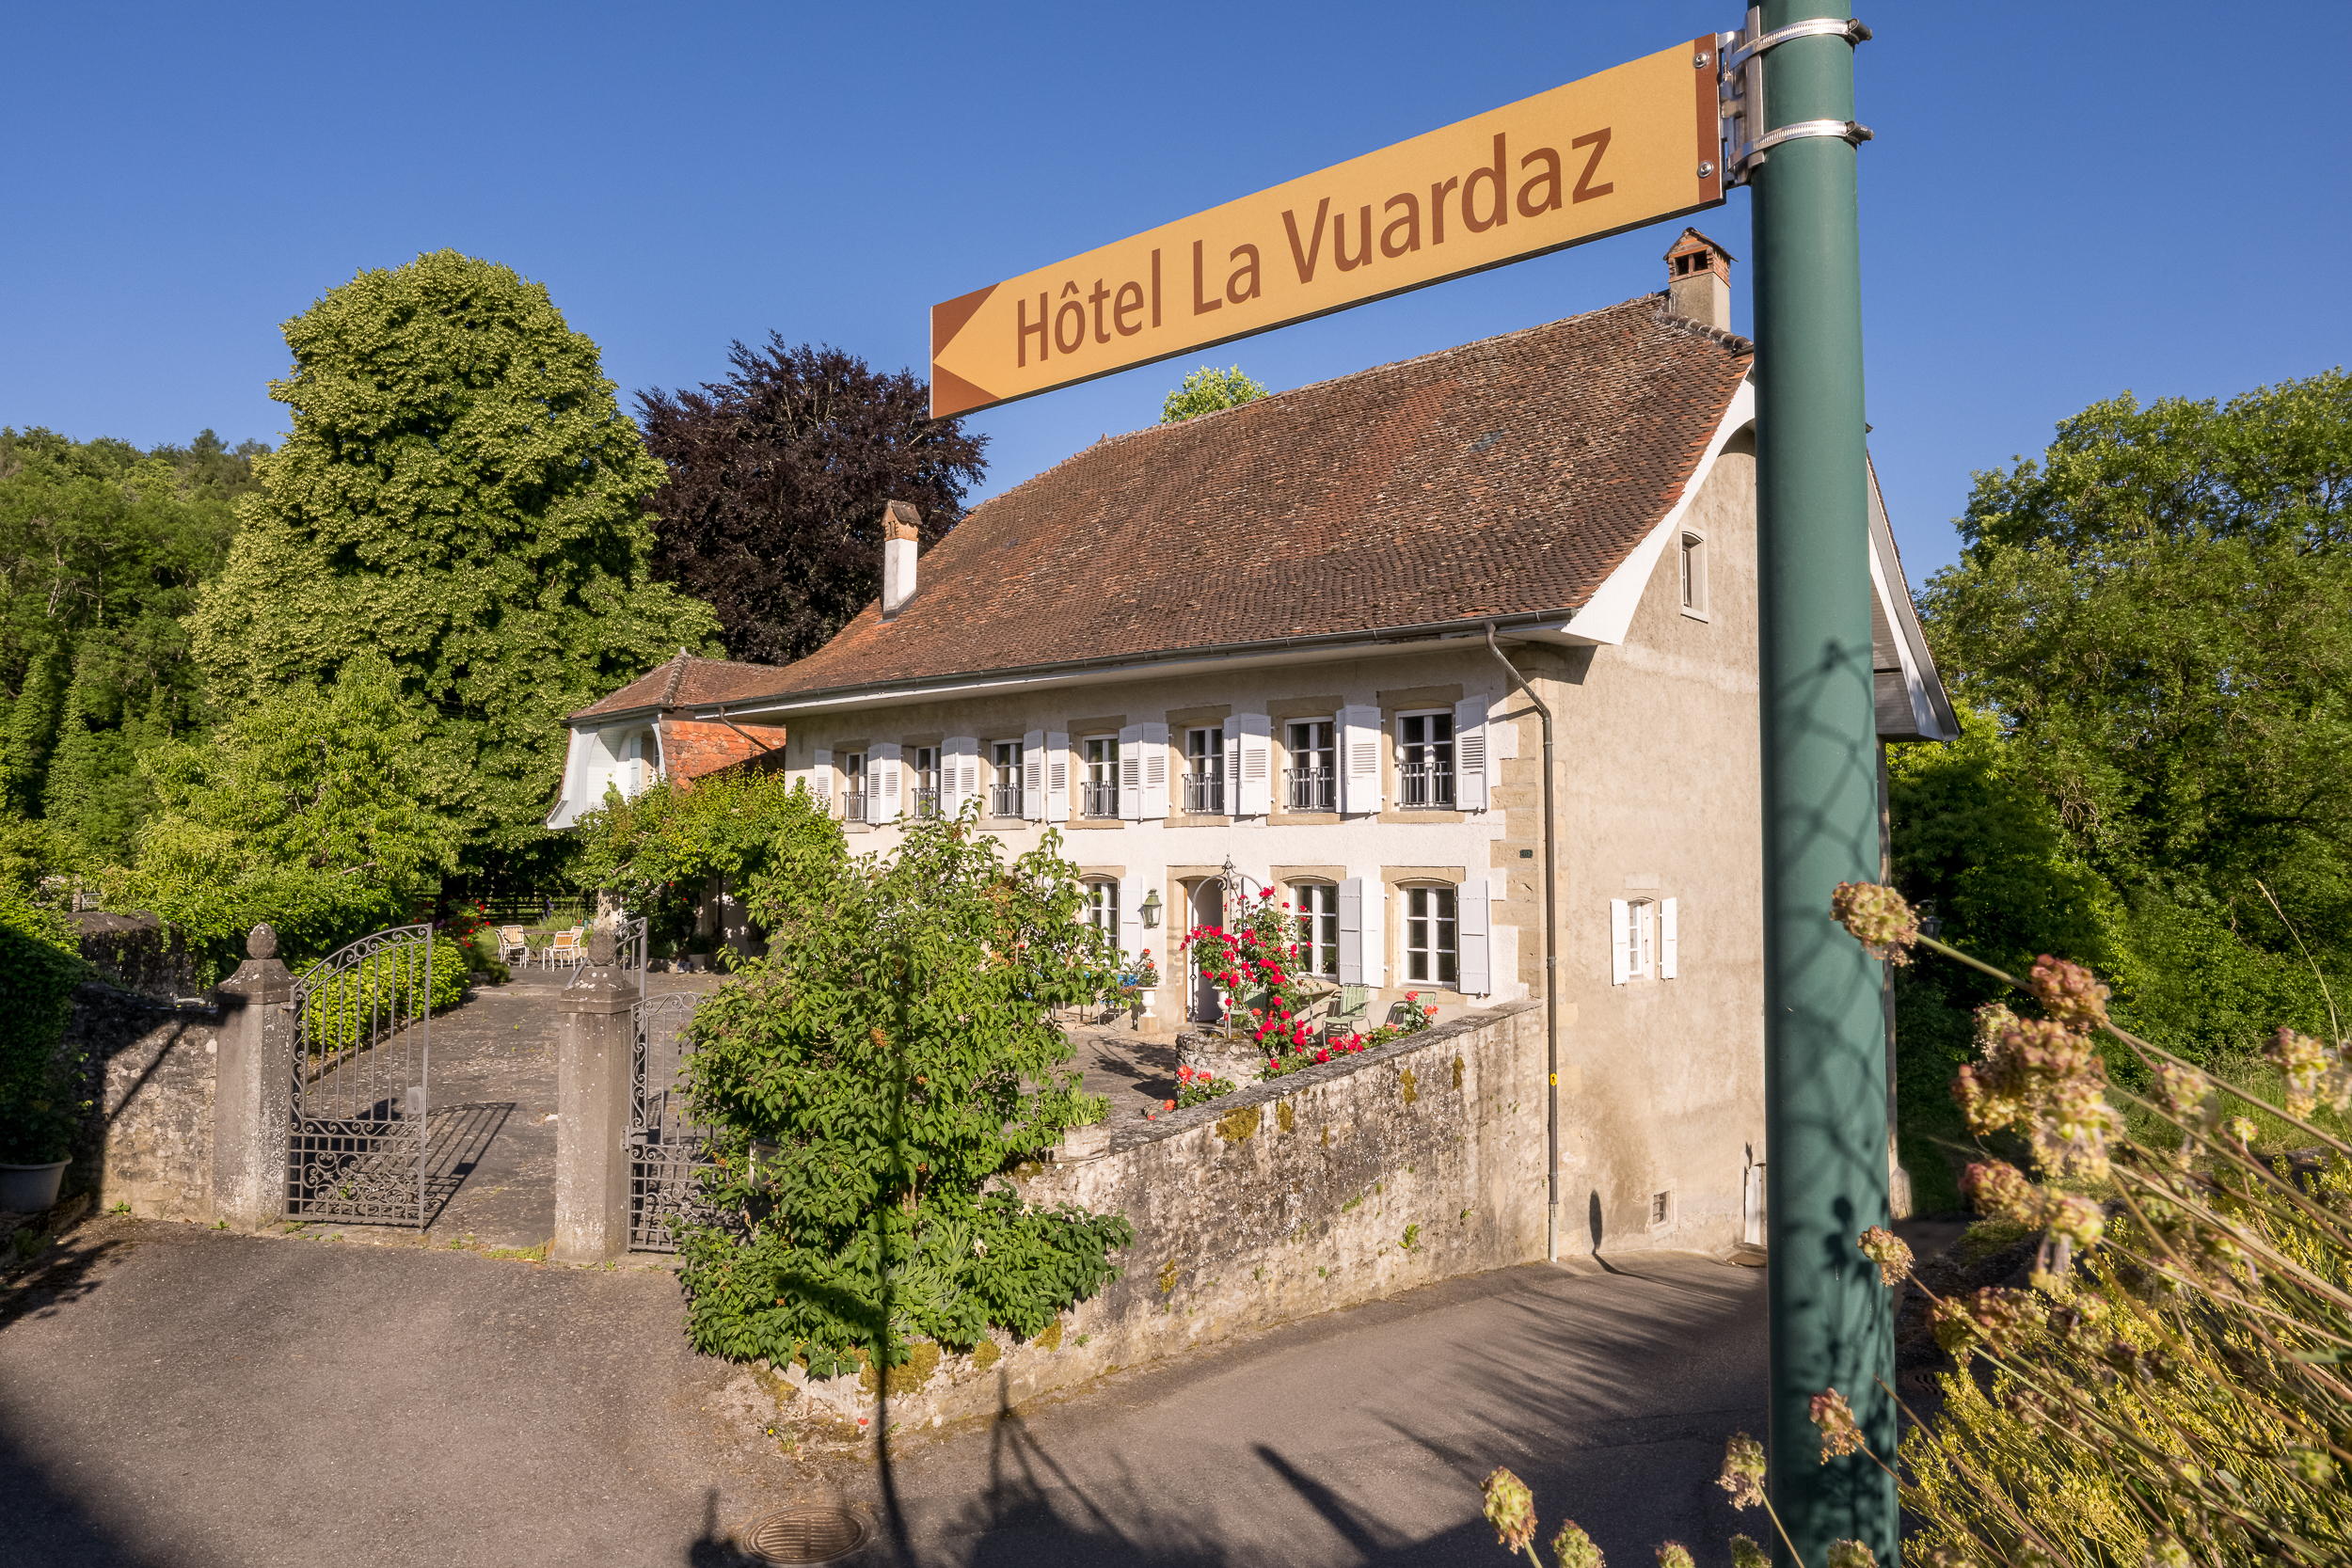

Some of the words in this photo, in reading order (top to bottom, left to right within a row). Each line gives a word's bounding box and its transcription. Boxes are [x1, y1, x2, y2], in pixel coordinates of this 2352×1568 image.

[1017, 248, 1162, 369] Hôtel
[1192, 239, 1262, 317] La
[1280, 126, 1614, 285] Vuardaz
